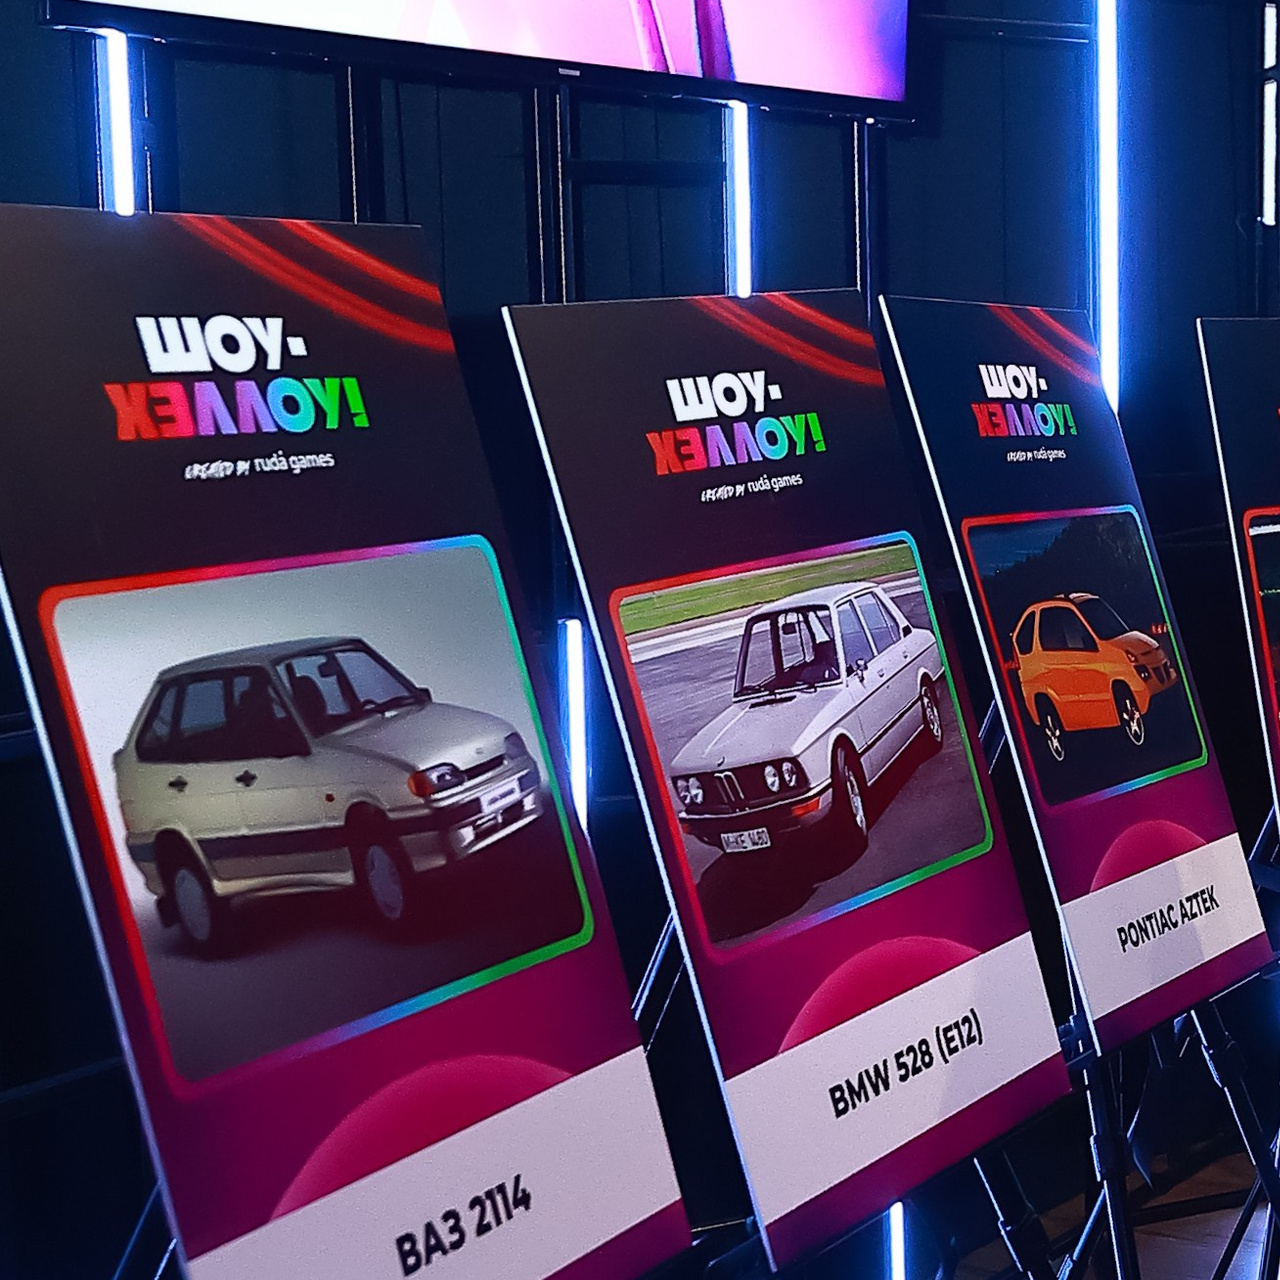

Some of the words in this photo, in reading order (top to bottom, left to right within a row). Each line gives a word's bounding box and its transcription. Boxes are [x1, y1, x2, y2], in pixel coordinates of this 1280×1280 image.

[135, 314, 308, 373] ШОУ-
[665, 370, 783, 422] ШОУ-
[978, 364, 1048, 399] ШОУ-
[289, 452, 335, 475] games
[771, 473, 803, 493] games
[1116, 904, 1179, 953] PONTIAC
[1178, 884, 1220, 925] AZTEK
[828, 1058, 890, 1119] BMW
[894, 1038, 934, 1083] 528
[935, 1007, 983, 1065] (E12)
[396, 1208, 466, 1277] ВАЗ
[469, 1173, 532, 1237] 2114
